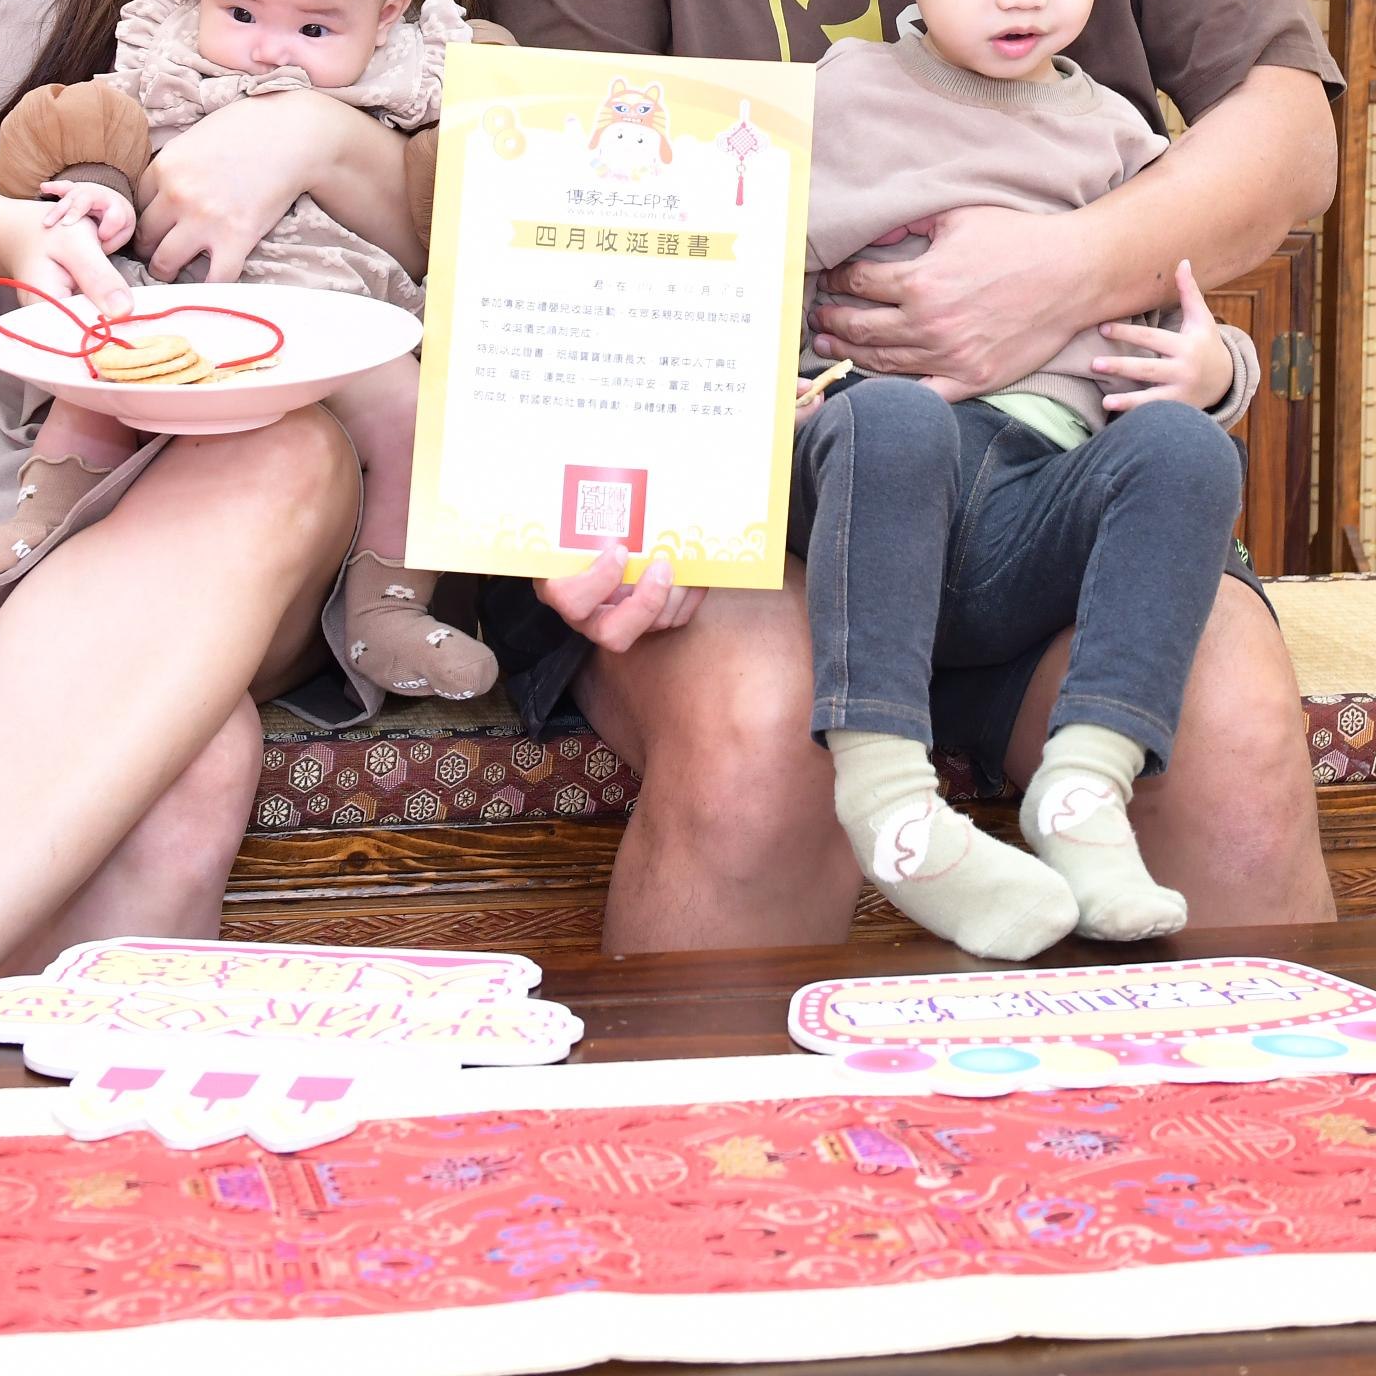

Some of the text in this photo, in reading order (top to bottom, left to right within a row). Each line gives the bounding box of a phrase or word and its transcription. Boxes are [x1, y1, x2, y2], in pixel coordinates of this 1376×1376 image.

[565, 189, 681, 212] 傳家手工印章
[535, 224, 711, 257] 四月收涎證書
